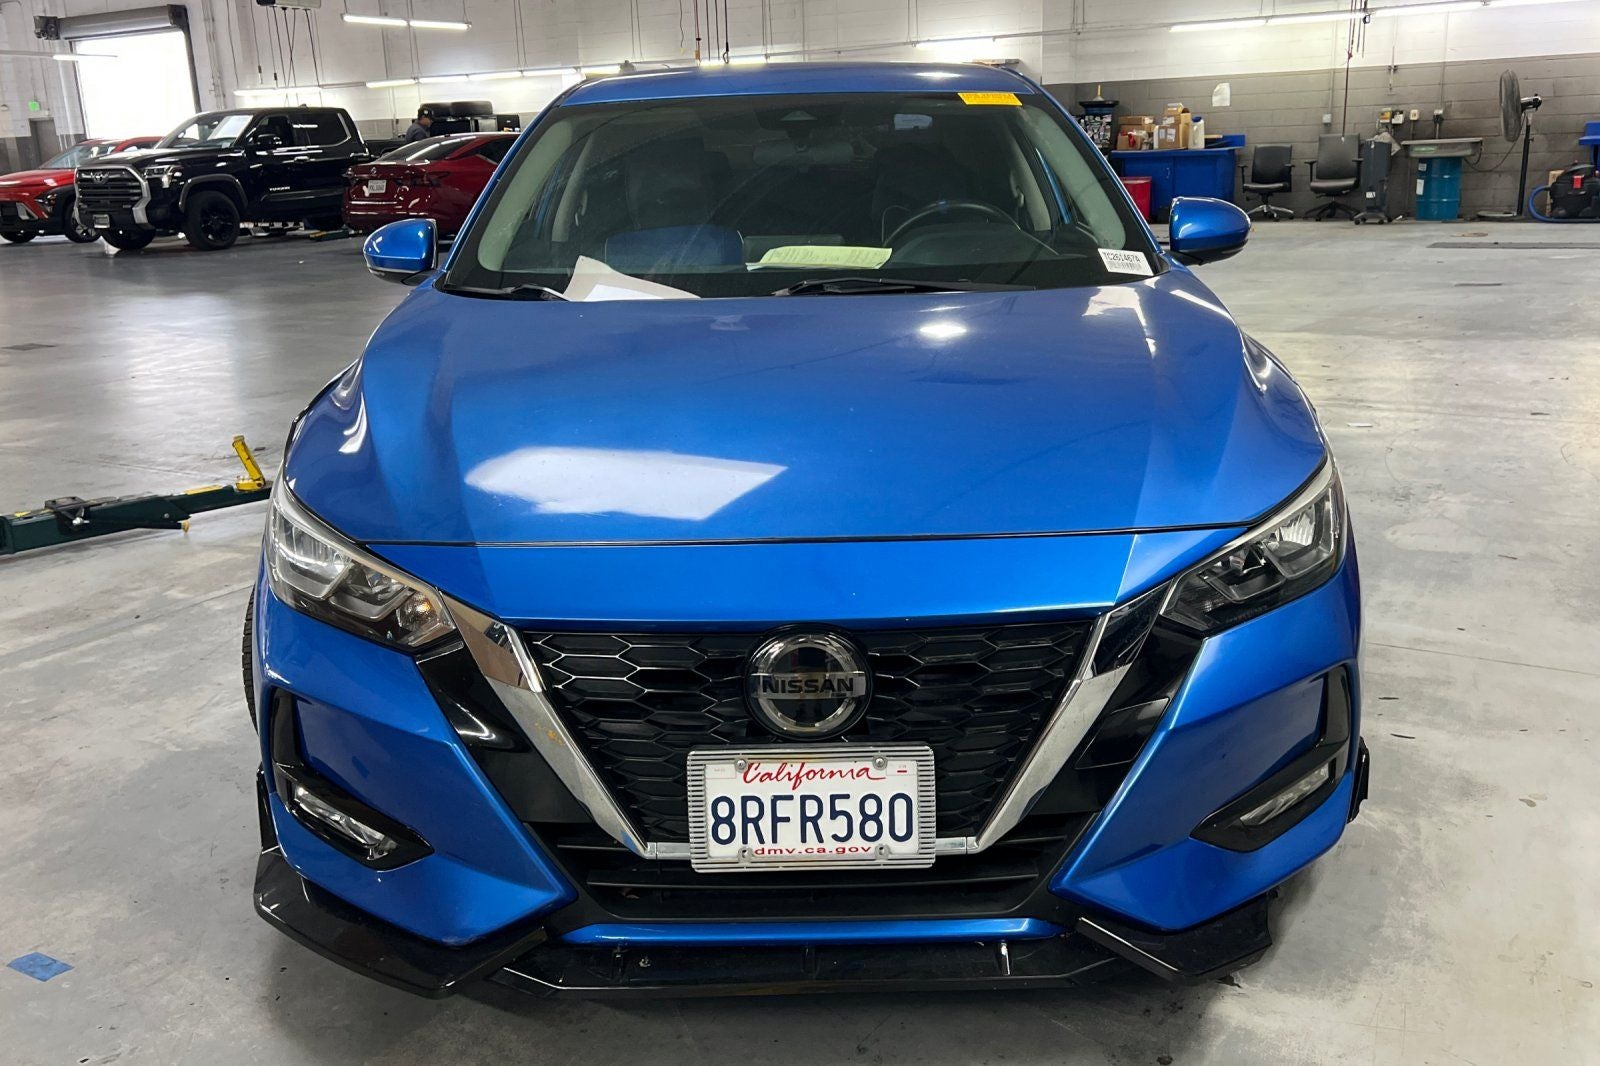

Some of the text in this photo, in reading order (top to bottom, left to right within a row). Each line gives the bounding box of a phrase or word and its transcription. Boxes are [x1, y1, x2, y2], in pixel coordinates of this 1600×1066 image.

[762, 678, 854, 694] NISSAN
[743, 762, 886, 791] California
[711, 792, 914, 845] 8RFR580
[754, 846, 872, 856] dmv.ca.gov
